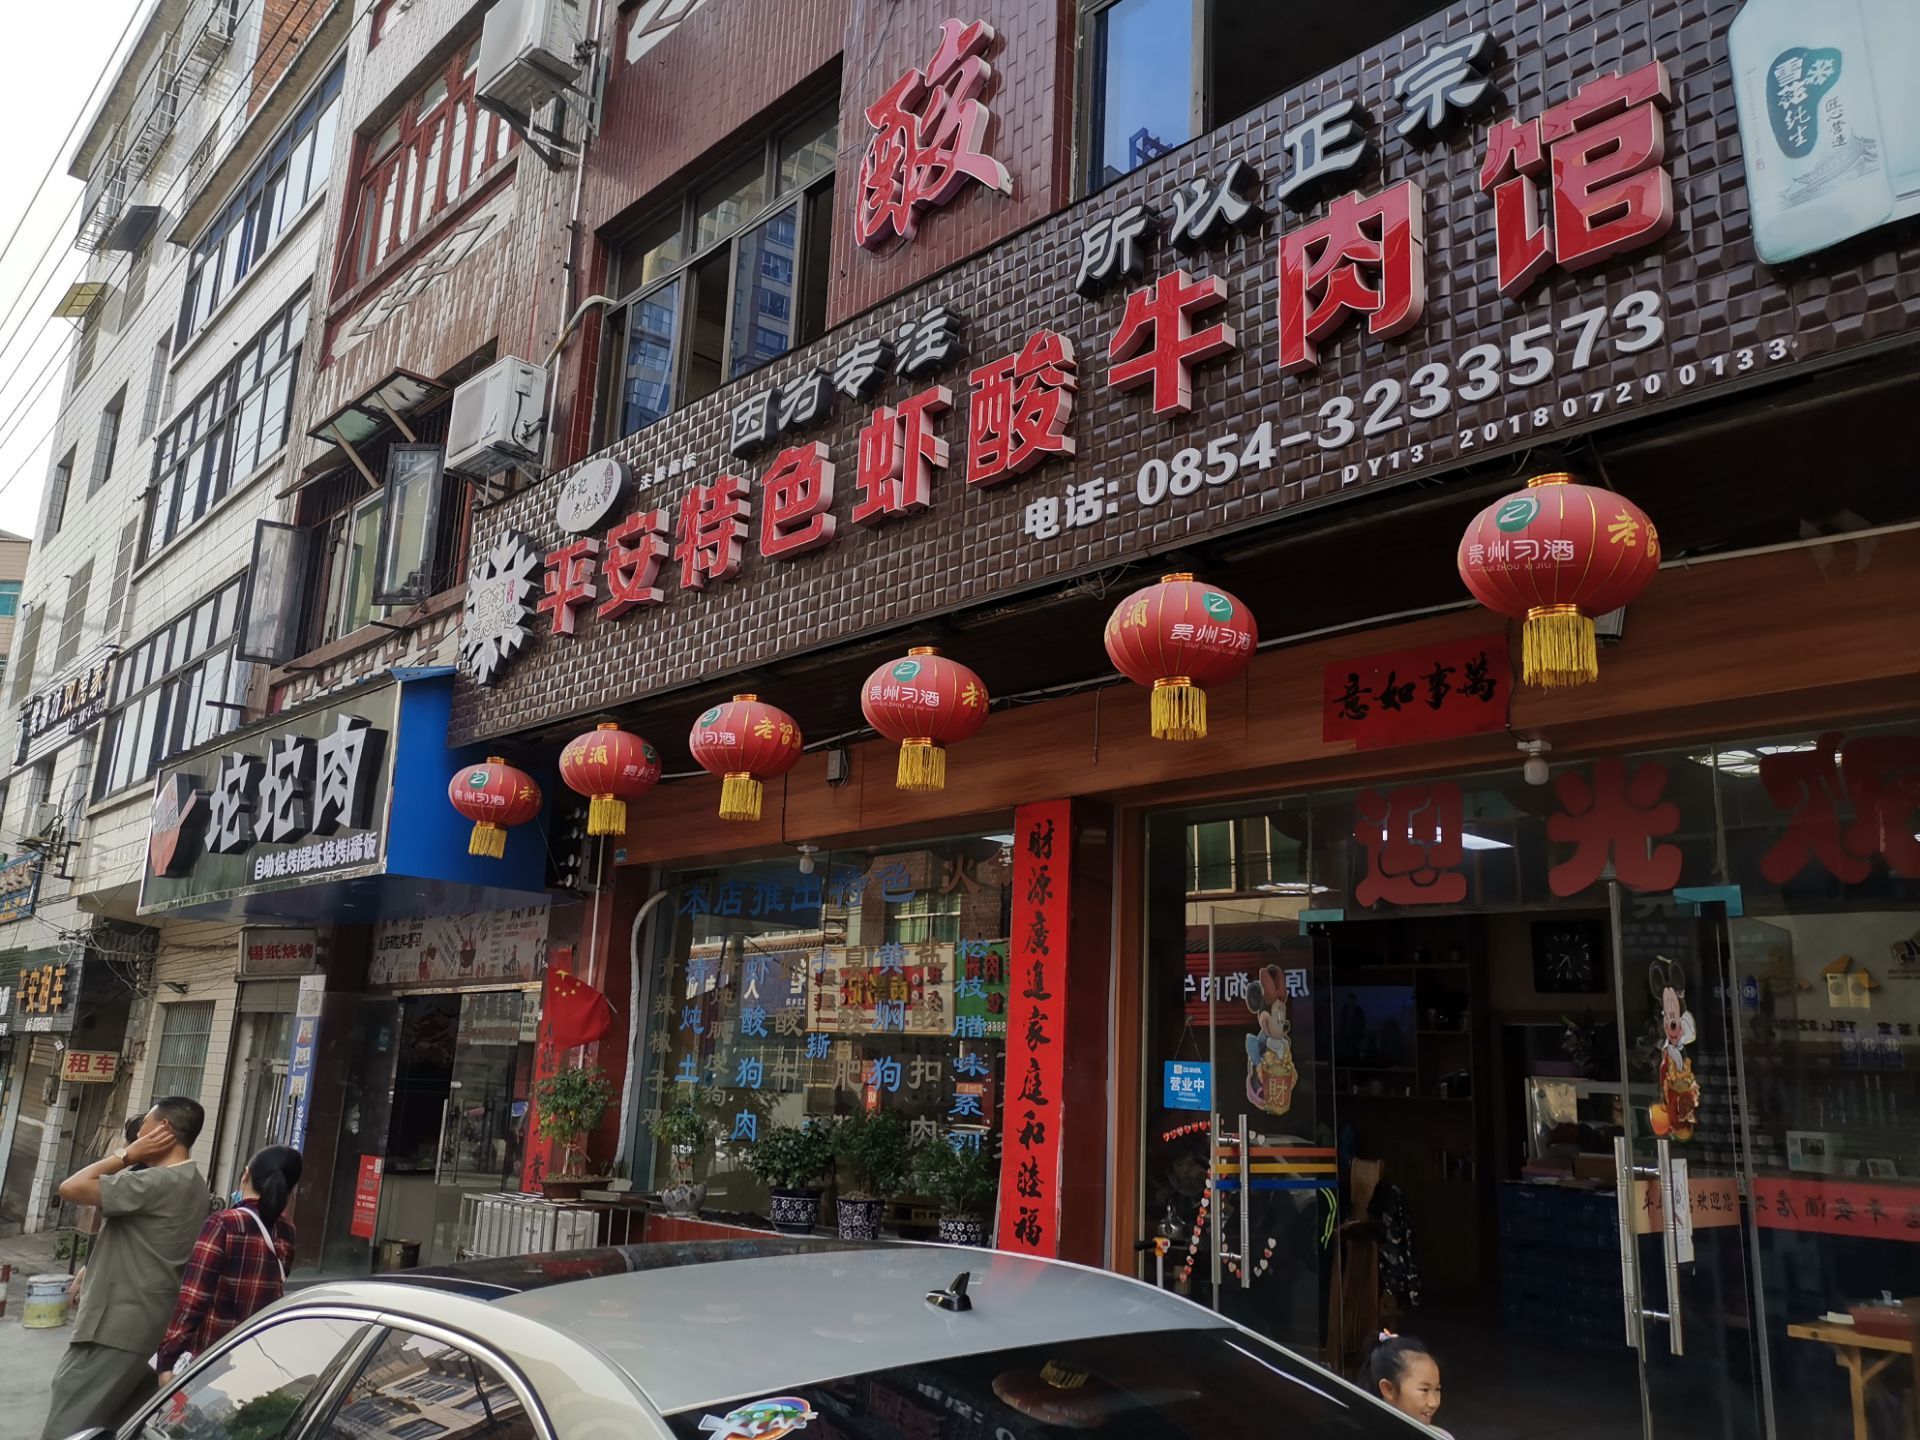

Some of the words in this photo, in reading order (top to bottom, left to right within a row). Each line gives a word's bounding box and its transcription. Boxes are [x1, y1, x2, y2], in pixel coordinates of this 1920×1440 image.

[1825, 96, 1848, 149] 匠心营造
[729, 306, 961, 460] 因为专注
[1074, 31, 1497, 297] 所以正宗
[537, 60, 1672, 635] 平安特色虾酸牛肉馆
[1136, 290, 1665, 506] 0854-3233573
[1343, 444, 1426, 484] DY13
[1469, 539, 1575, 565] 贵州习酒
[1496, 563, 1521, 571] ZHOU
[1170, 623, 1252, 651] 贵州习酒
[870, 685, 939, 706] 贵州习酒
[204, 713, 386, 854] 坨坨肉
[455, 788, 505, 806] 贵州习酒
[249, 943, 314, 960] 锡纸烧烤
[730, 953, 773, 1142] 虾酸狗肉
[946, 937, 991, 1155] 松枝腊味系列
[67, 1053, 117, 1075] 租车
[1170, 1076, 1205, 1093] 营业中
